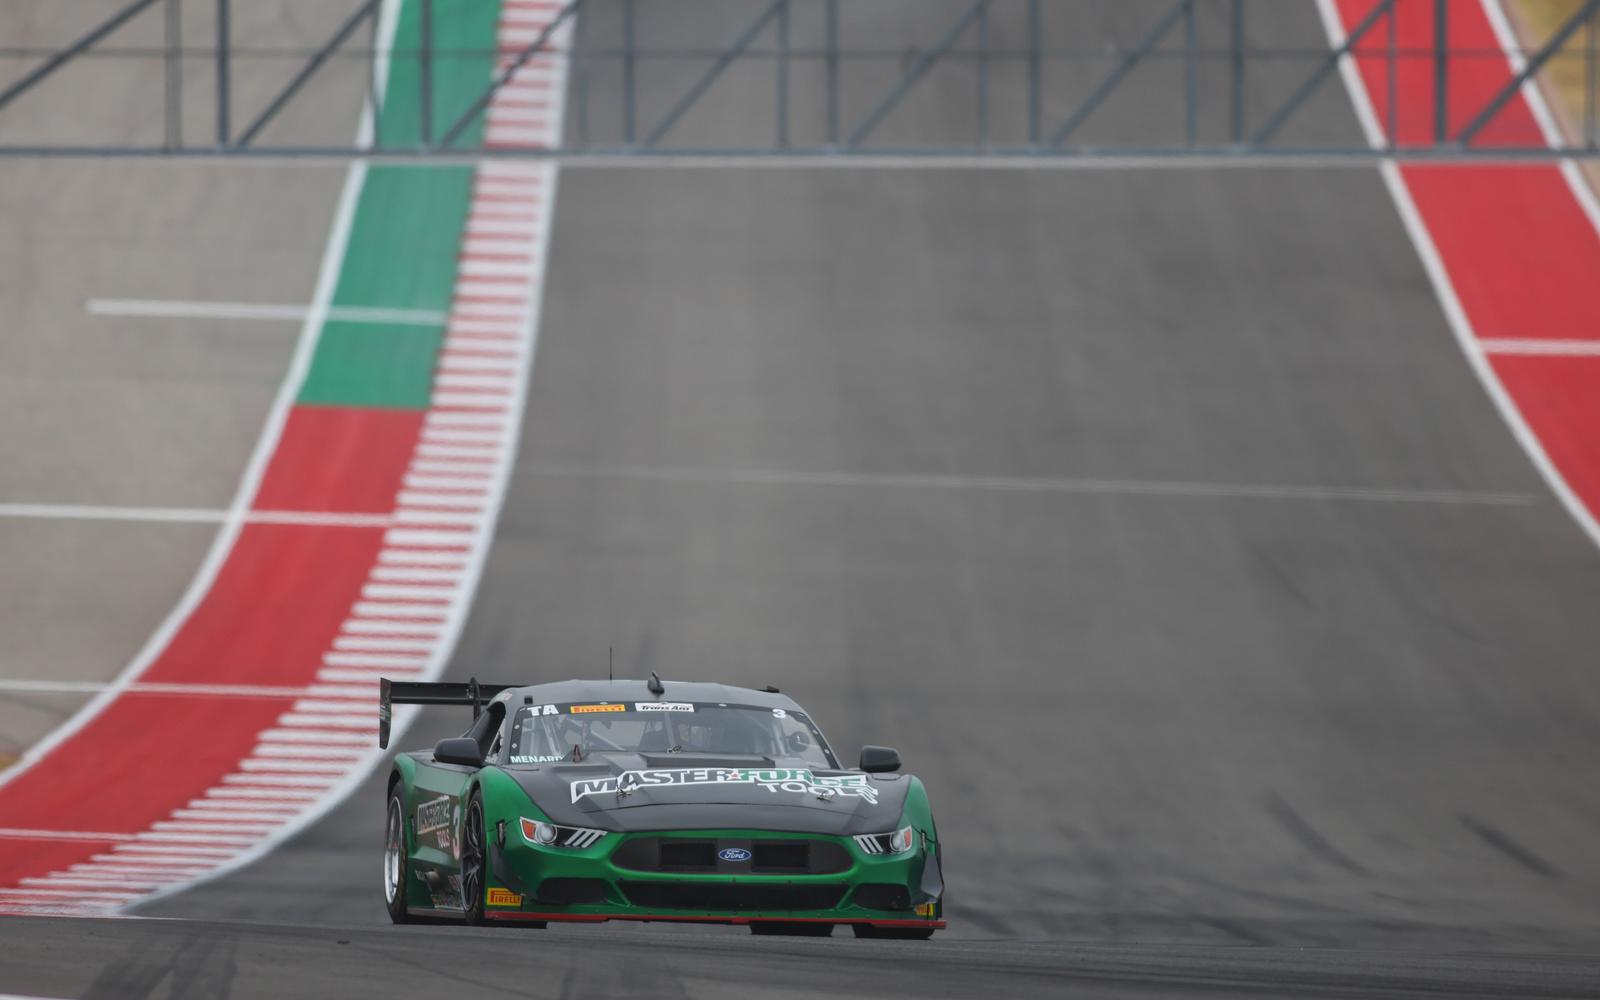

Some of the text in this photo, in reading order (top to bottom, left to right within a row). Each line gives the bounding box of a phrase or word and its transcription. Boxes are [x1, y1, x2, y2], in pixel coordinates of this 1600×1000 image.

[527, 704, 560, 717] TA
[772, 708, 787, 719] 3
[452, 805, 461, 860] 3
[724, 849, 746, 859] Ford
